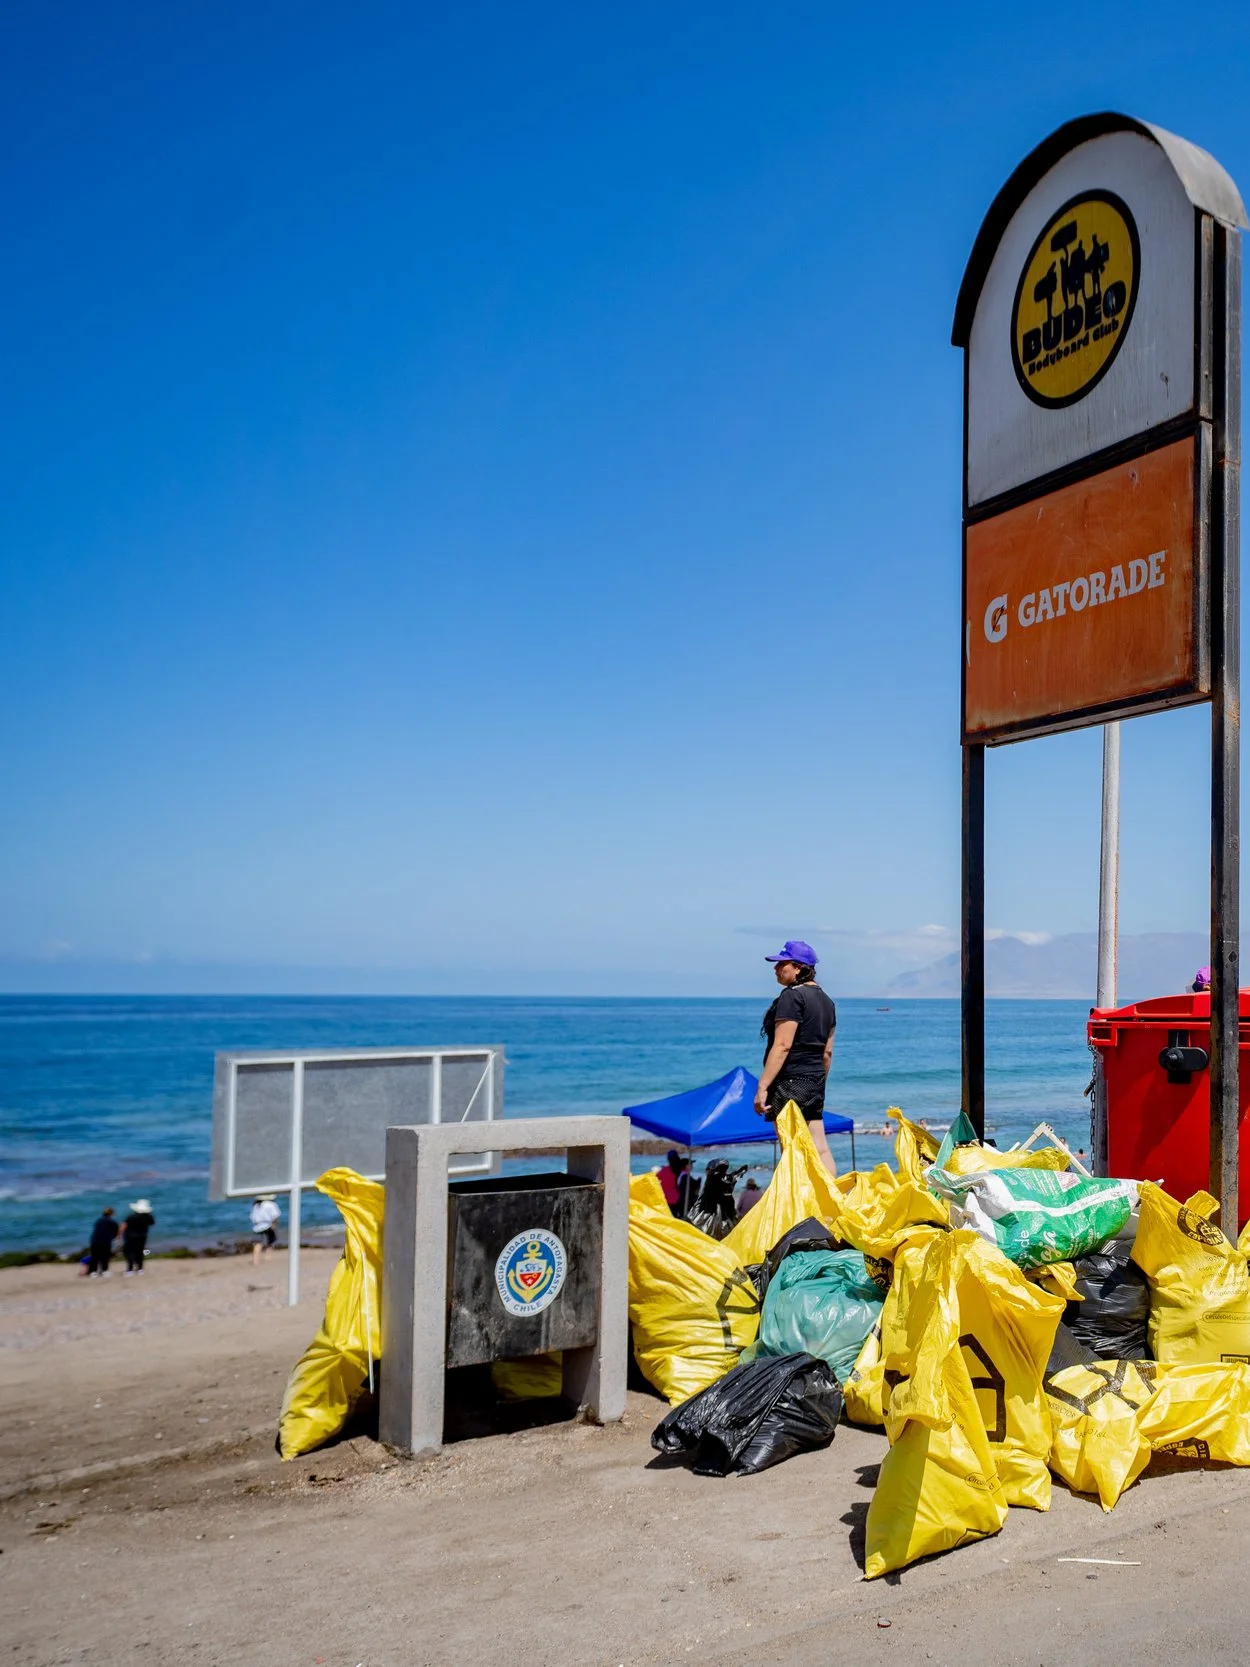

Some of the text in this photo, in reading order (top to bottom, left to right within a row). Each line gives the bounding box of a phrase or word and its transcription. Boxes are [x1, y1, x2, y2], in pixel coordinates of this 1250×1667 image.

[1022, 280, 1126, 365] BUDEO
[1028, 318, 1119, 376] Bodyboard Club
[1017, 549, 1166, 628] GATORADE
[497, 1236, 526, 1303] MUNICIPALIDAD
[544, 1236, 563, 1295] ANTOFAGASTA
[513, 1302, 542, 1312] CHILE
